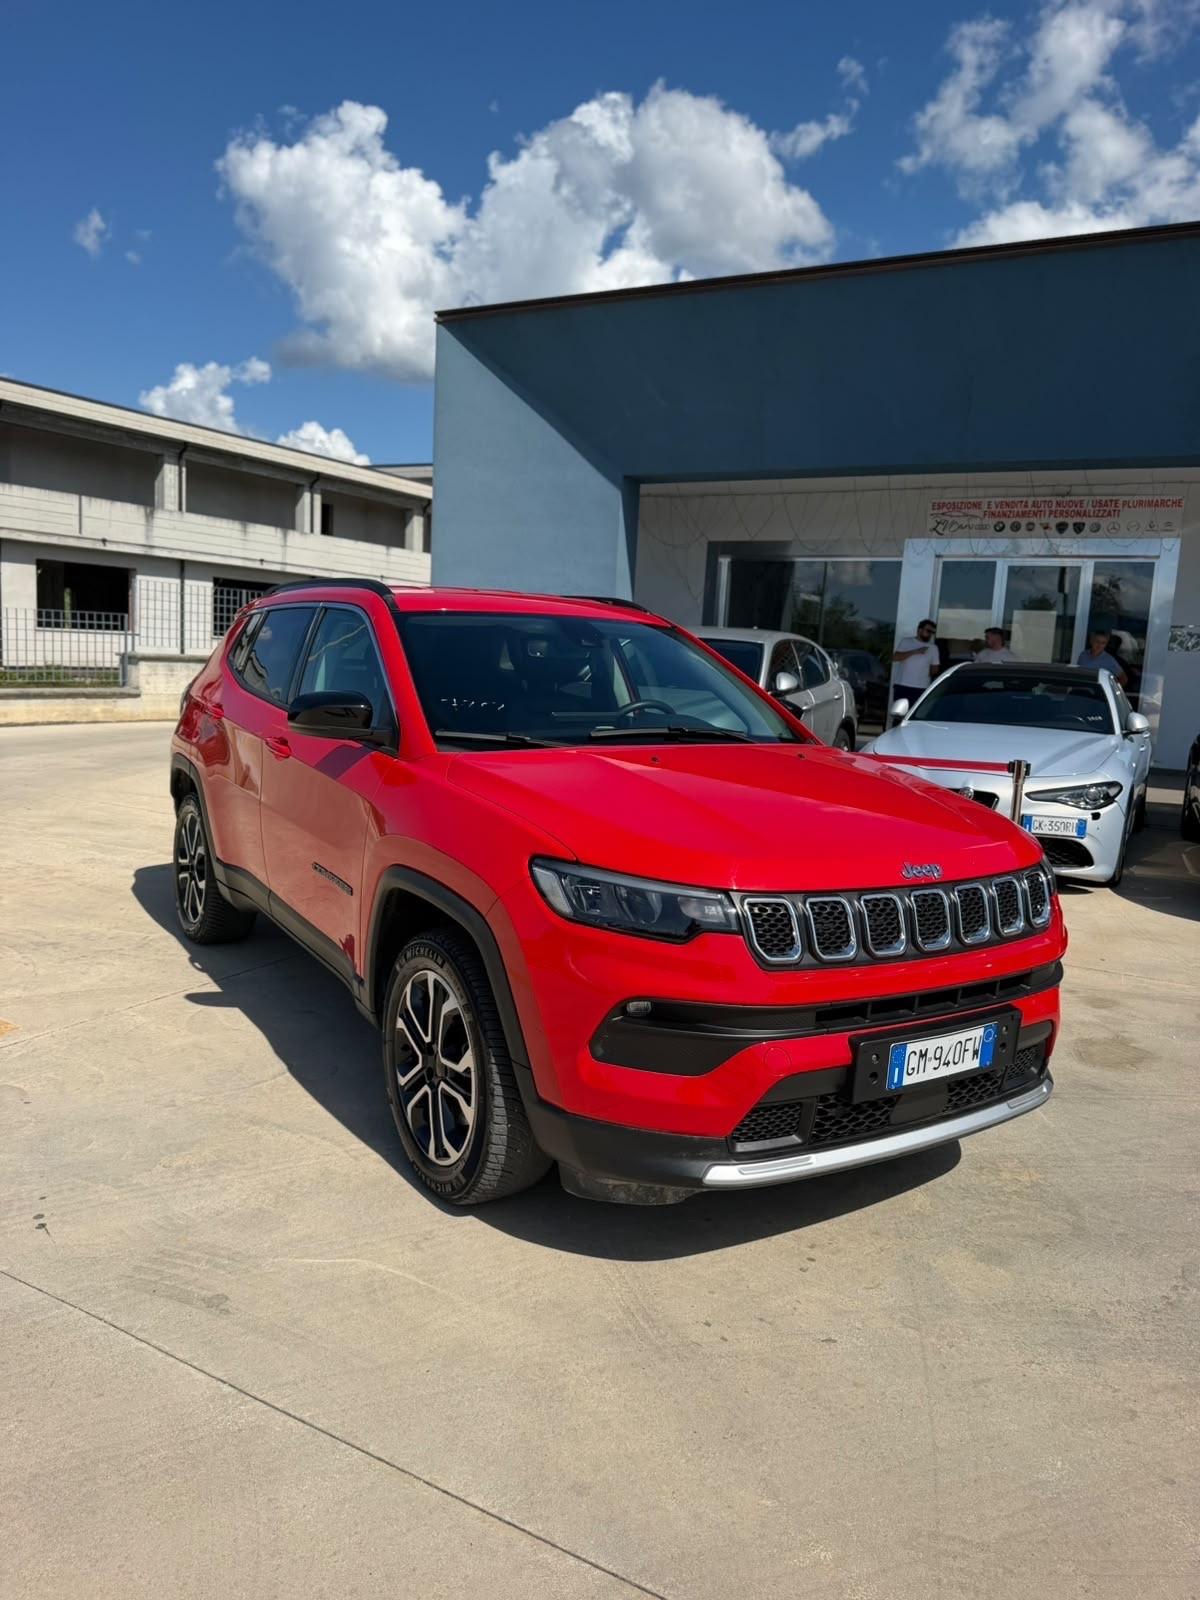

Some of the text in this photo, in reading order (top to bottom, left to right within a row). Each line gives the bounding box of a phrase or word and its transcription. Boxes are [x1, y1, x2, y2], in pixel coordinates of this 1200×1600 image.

[931, 501, 983, 511] ESPOSIZIONE
[987, 501, 993, 509] E
[994, 500, 1029, 509] VENDITA
[1031, 500, 1053, 509] AUTO
[1055, 500, 1084, 509] NUOVE
[1091, 499, 1120, 508] USATE
[1122, 498, 1184, 509] PLURIMARCHE
[983, 509, 1121, 519] FINANZIAMENTI PERSONALIZZATI
[901, 861, 943, 880] Jeep
